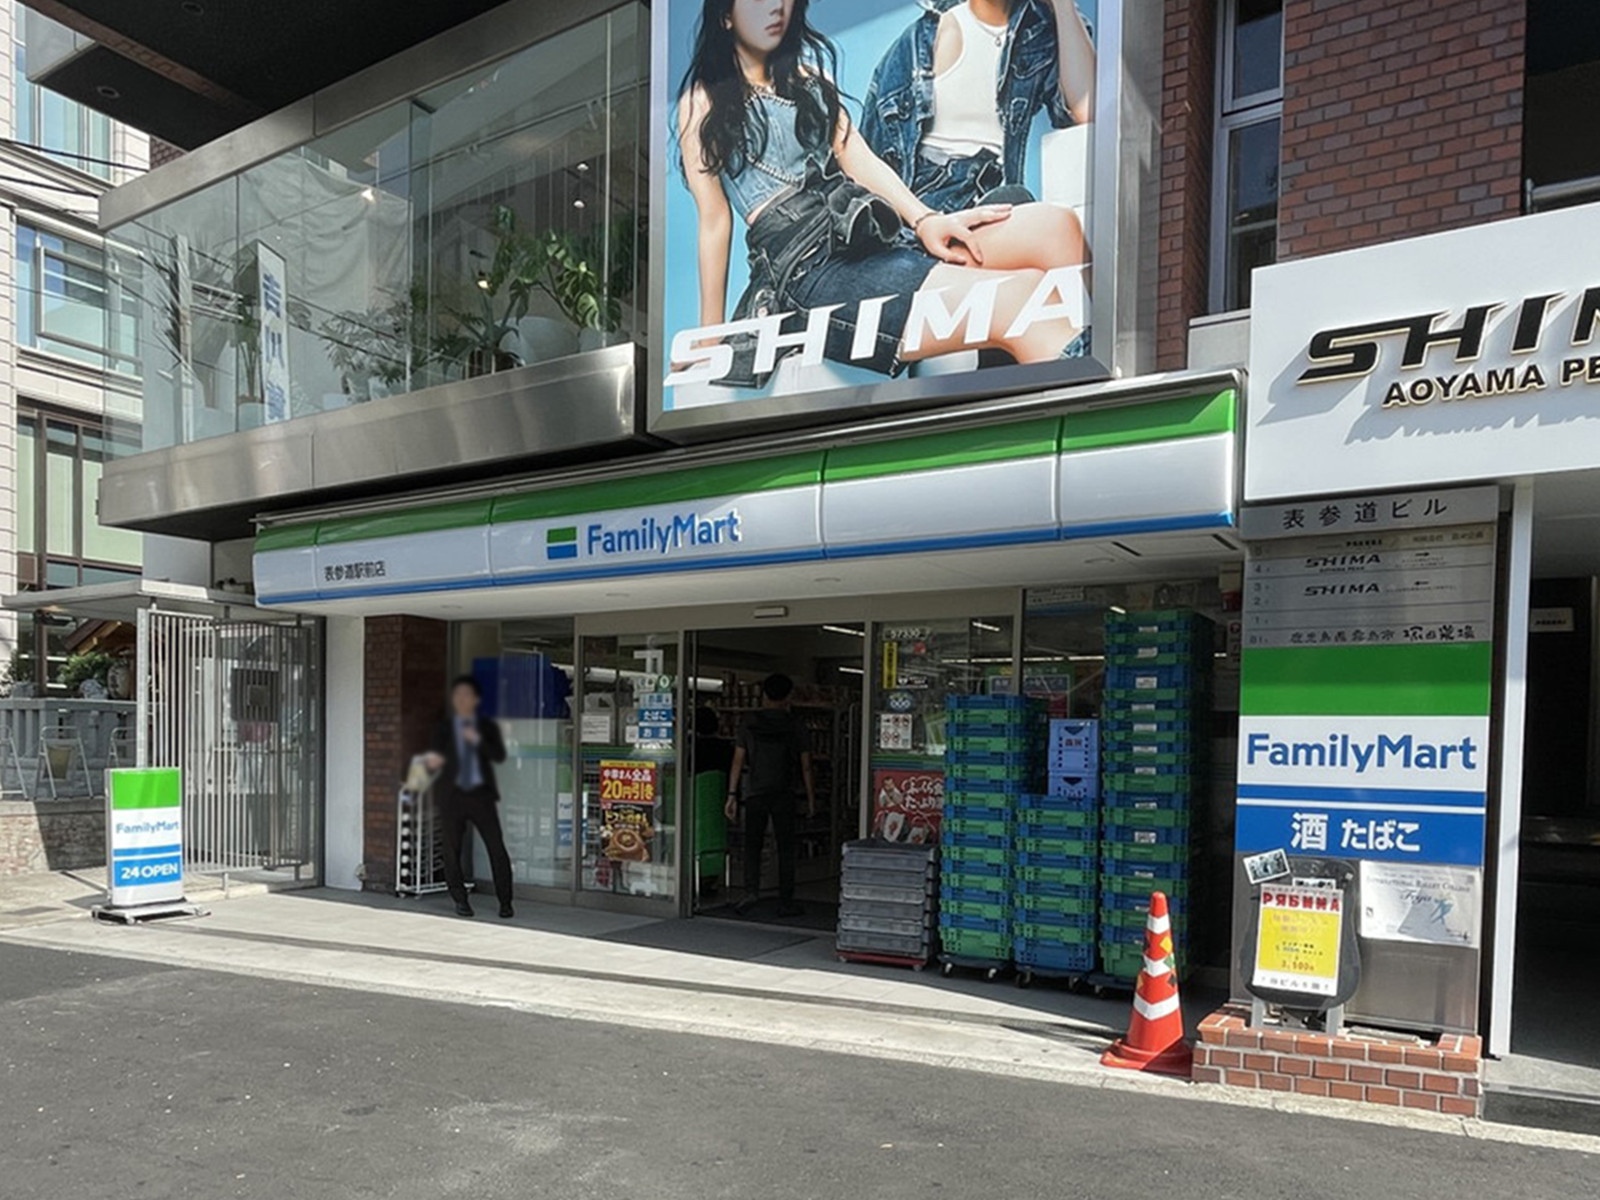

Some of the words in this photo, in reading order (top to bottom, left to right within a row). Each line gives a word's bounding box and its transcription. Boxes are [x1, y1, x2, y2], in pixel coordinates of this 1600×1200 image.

[663, 263, 1092, 386] SHIMA
[1382, 364, 1546, 407] AOYAMA
[1283, 497, 1448, 530] 表参道ビル
[587, 510, 742, 555] FamilyMart
[324, 560, 386, 581] 表参道駅前店
[1304, 554, 1381, 568] SHIMA
[1304, 583, 1380, 596] SHIMA
[1247, 733, 1477, 773] FamilyMart
[601, 780, 655, 800] 20円引き
[115, 821, 180, 834] FamilyMart
[1290, 812, 1328, 850] 酒
[1340, 818, 1421, 851] たばこ
[121, 866, 140, 880] 24
[141, 863, 179, 878] OPEN
